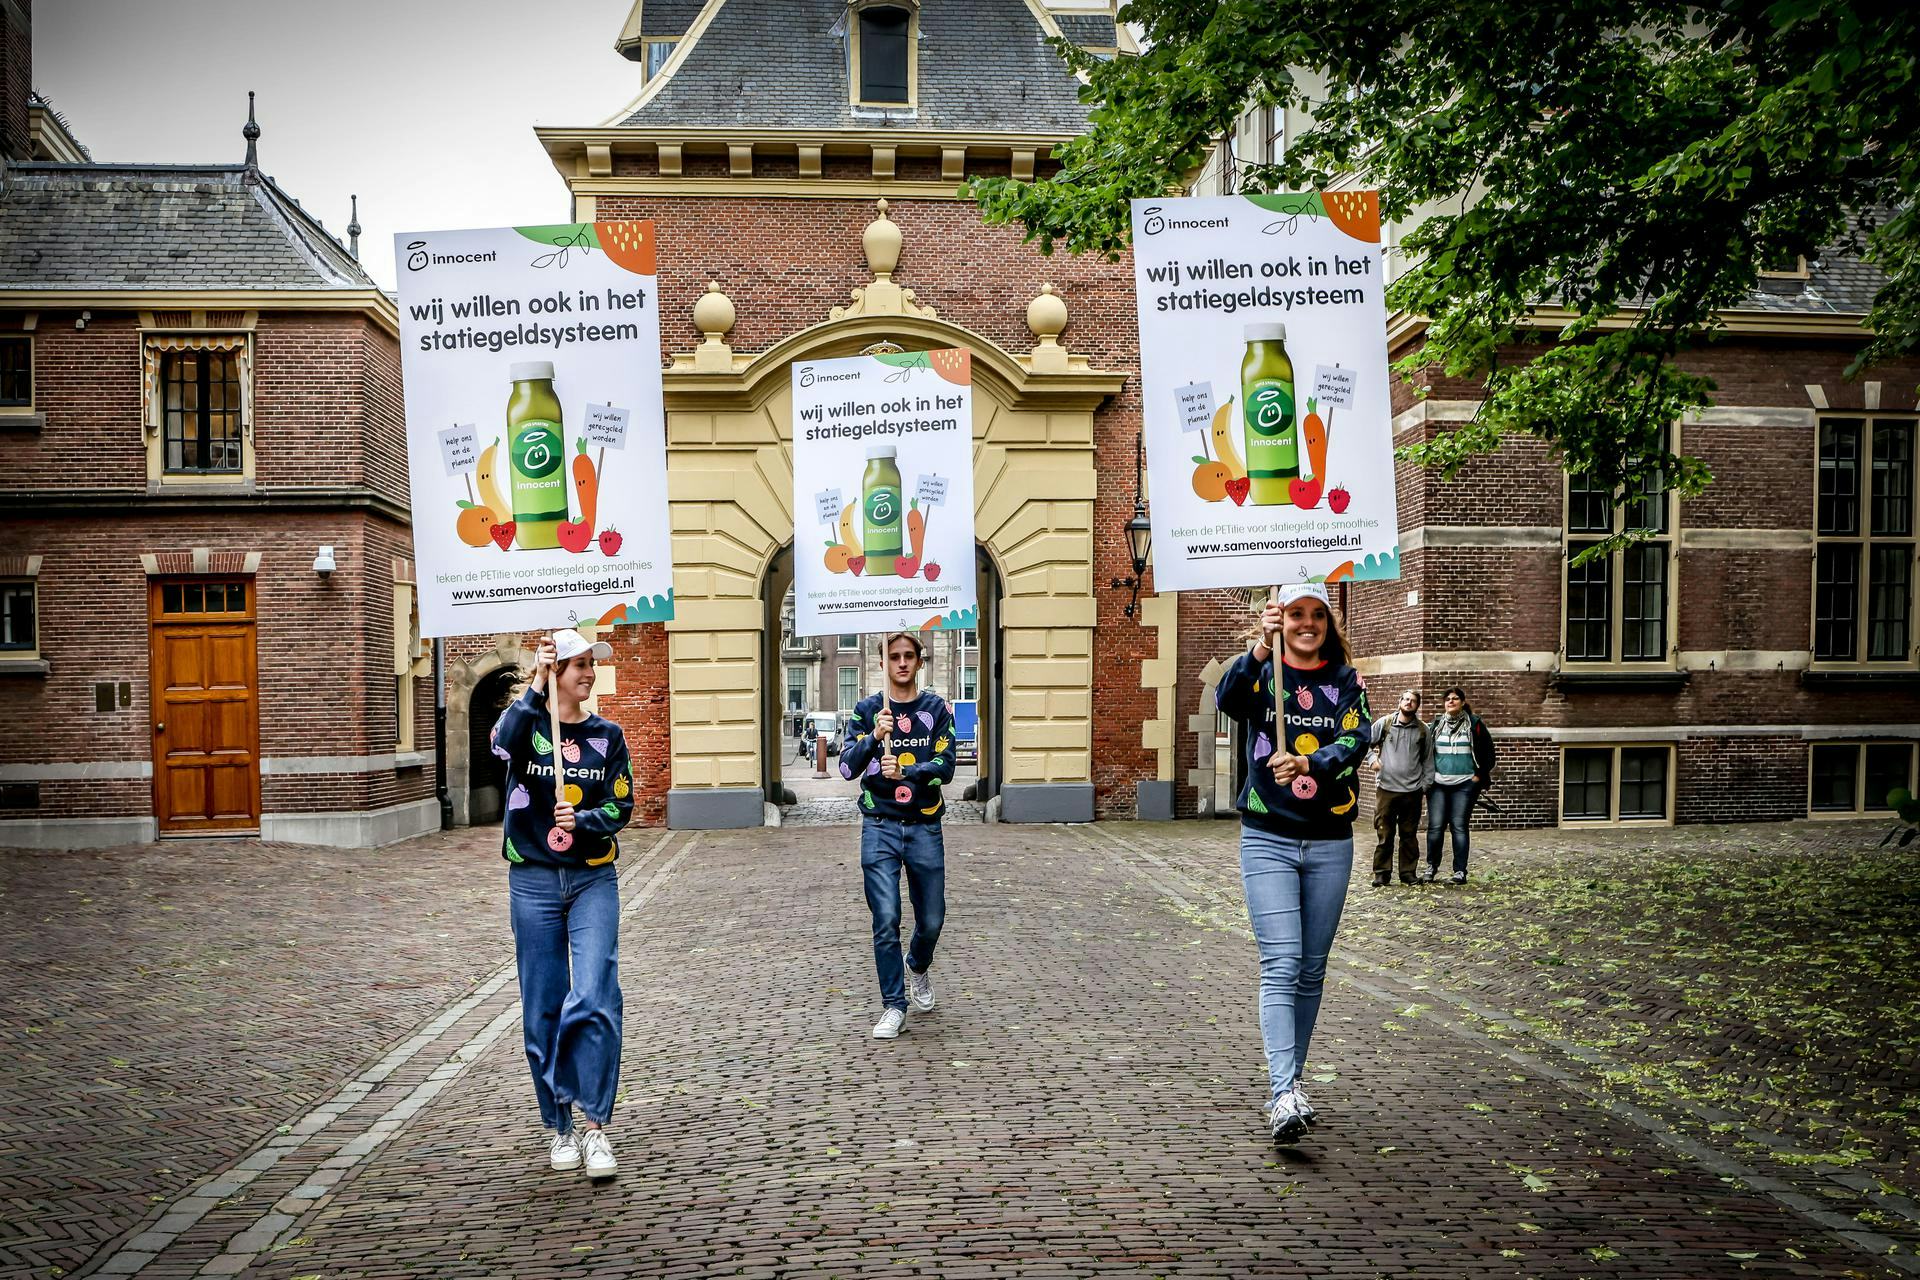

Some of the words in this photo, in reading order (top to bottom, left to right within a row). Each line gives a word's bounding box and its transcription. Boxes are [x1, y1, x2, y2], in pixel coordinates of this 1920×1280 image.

[1168, 217, 1229, 230] innocent
[433, 250, 497, 265] innocent
[1146, 261, 1180, 287] wij
[1187, 258, 1252, 281] willen
[1260, 256, 1301, 277] ook
[1308, 255, 1328, 277] in
[1335, 254, 1371, 275] het
[1157, 285, 1364, 313] statiegeldsysteem
[410, 298, 443, 325] wij
[451, 295, 520, 318] willen
[528, 291, 572, 314] ook
[579, 290, 599, 311] in
[607, 288, 646, 309] het
[420, 322, 638, 352] statiegeldsysteem
[817, 371, 861, 383] innocent
[1322, 373, 1331, 382] wij
[1332, 374, 1350, 384] willen
[1317, 384, 1351, 396] gerecycled
[1181, 393, 1195, 403] help
[1196, 392, 1208, 400] ons
[1321, 395, 1344, 404] worden
[800, 405, 823, 422] wij
[828, 401, 875, 417] willen
[881, 397, 911, 414] ook
[916, 396, 930, 411] in
[936, 394, 963, 409] het
[1188, 405, 1197, 413] en
[1198, 403, 1206, 411] de
[593, 413, 602, 421] wij
[604, 413, 622, 422] willen
[588, 423, 623, 434] gerecycled
[806, 418, 957, 440] statiegeldsysteem
[445, 437, 459, 446] help
[592, 435, 616, 443] worden
[1250, 437, 1293, 447] innocent
[517, 480, 560, 490] innocent
[867, 526, 898, 534] innocent
[1171, 528, 1198, 538] teken
[1200, 526, 1213, 536] de
[1215, 525, 1245, 536] PETitie
[1247, 524, 1269, 533] voor
[1270, 520, 1315, 535] statiegeld
[1316, 521, 1329, 532] op
[1331, 518, 1379, 530] smoothies
[1187, 534, 1362, 554] www.samenvoorstatiegeld.nl
[436, 573, 463, 583] teken
[465, 570, 478, 581] de
[481, 568, 511, 581] PETitie
[513, 569, 535, 578] voor
[537, 564, 585, 580] statiegeld
[586, 564, 600, 576] op
[602, 560, 652, 573] smoothies
[452, 576, 635, 600] www.samenvoorstatiegeld.nl
[807, 591, 826, 599] teken
[828, 590, 838, 598] de
[839, 588, 860, 597] PETitie
[861, 588, 877, 596] voor
[879, 585, 913, 597] statiegeld
[914, 586, 924, 595] op
[925, 583, 962, 593] smoothies
[818, 596, 948, 611] www.samenvoorstatiegeld.nl
